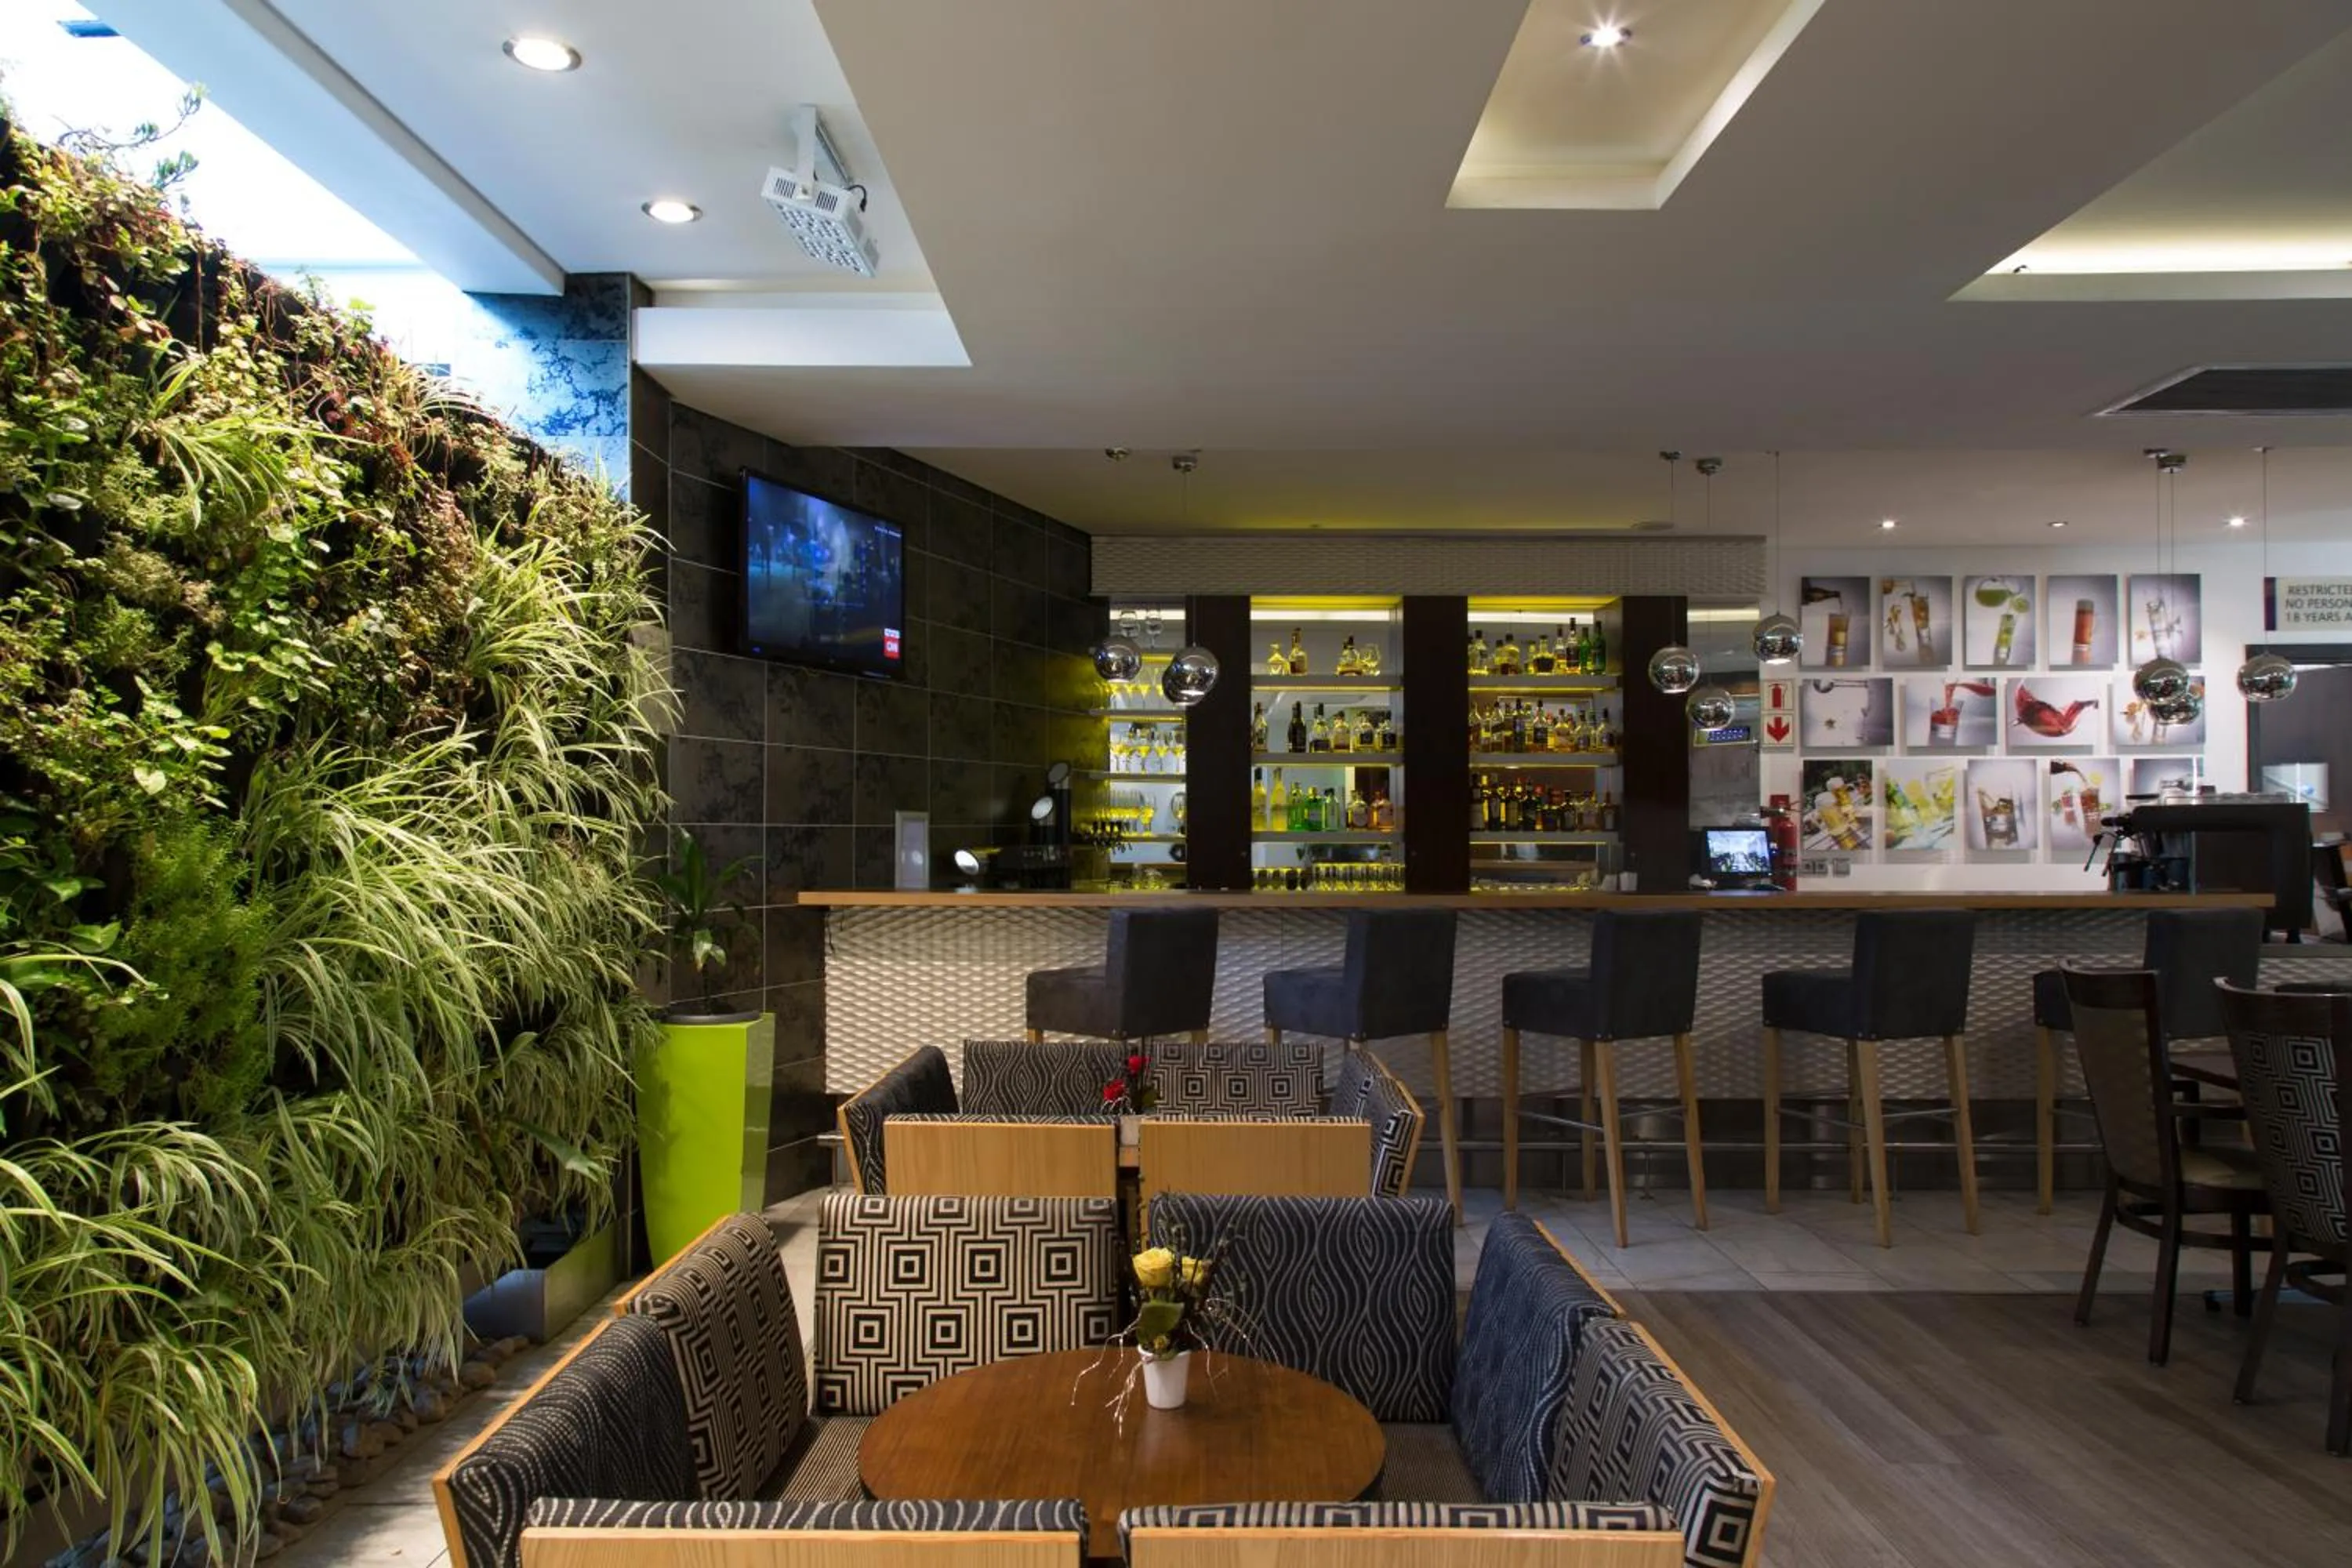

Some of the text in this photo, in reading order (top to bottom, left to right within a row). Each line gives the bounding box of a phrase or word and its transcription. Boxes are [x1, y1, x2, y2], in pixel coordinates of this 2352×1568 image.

[2288, 584, 2352, 595] RESTRICTE
[2285, 597, 2304, 609] NO
[2287, 612, 2300, 622] 18
[2303, 612, 2340, 622] YEARS
